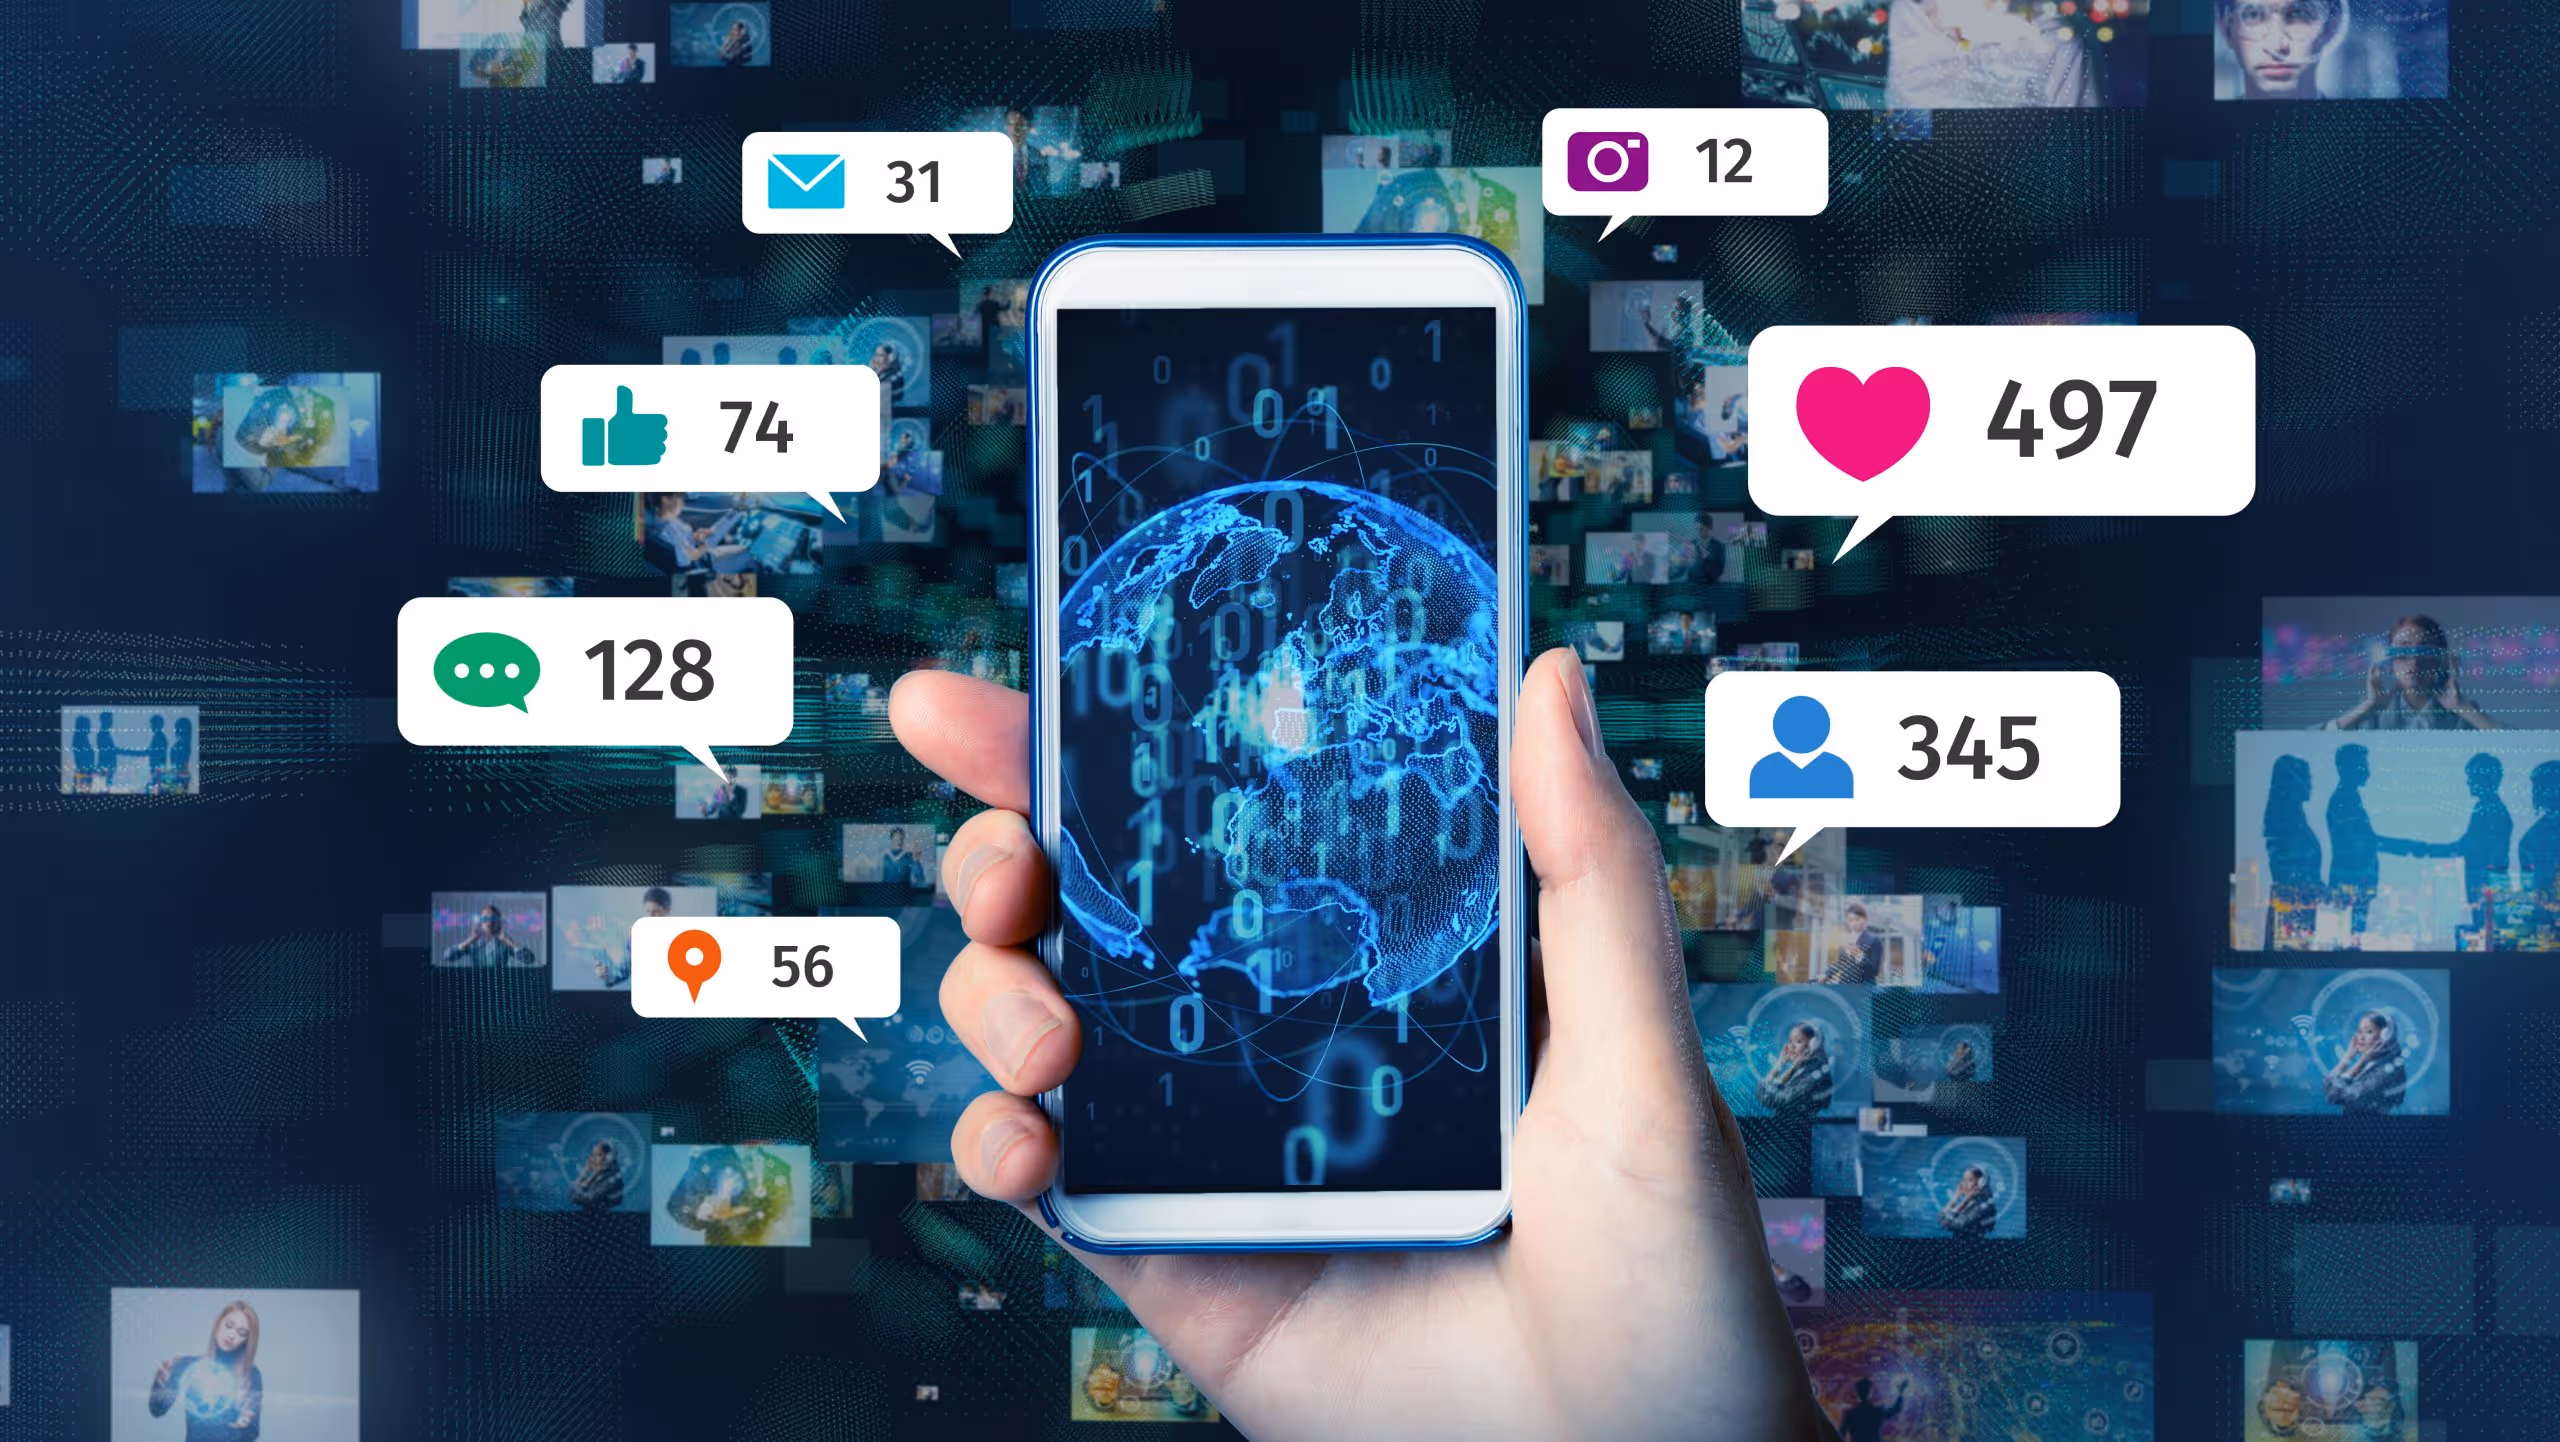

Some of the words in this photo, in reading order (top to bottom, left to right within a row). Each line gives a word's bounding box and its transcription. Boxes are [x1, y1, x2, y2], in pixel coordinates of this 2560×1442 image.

[1424, 320, 1441, 362] 1
[1154, 355, 1171, 384] 0
[1370, 357, 1392, 391] 0
[1253, 388, 1283, 438] 0
[1195, 436, 1210, 460] 0
[1425, 447, 1437, 467] 0
[1078, 469, 1092, 502] 1
[1063, 535, 1088, 576] 0
[1127, 860, 1153, 926] 1
[1233, 889, 1263, 938] 0
[1170, 995, 1205, 1052] 0
[1159, 1072, 1173, 1106] 1
[1372, 1066, 1403, 1117] 0
[1284, 1125, 1326, 1185] 0
